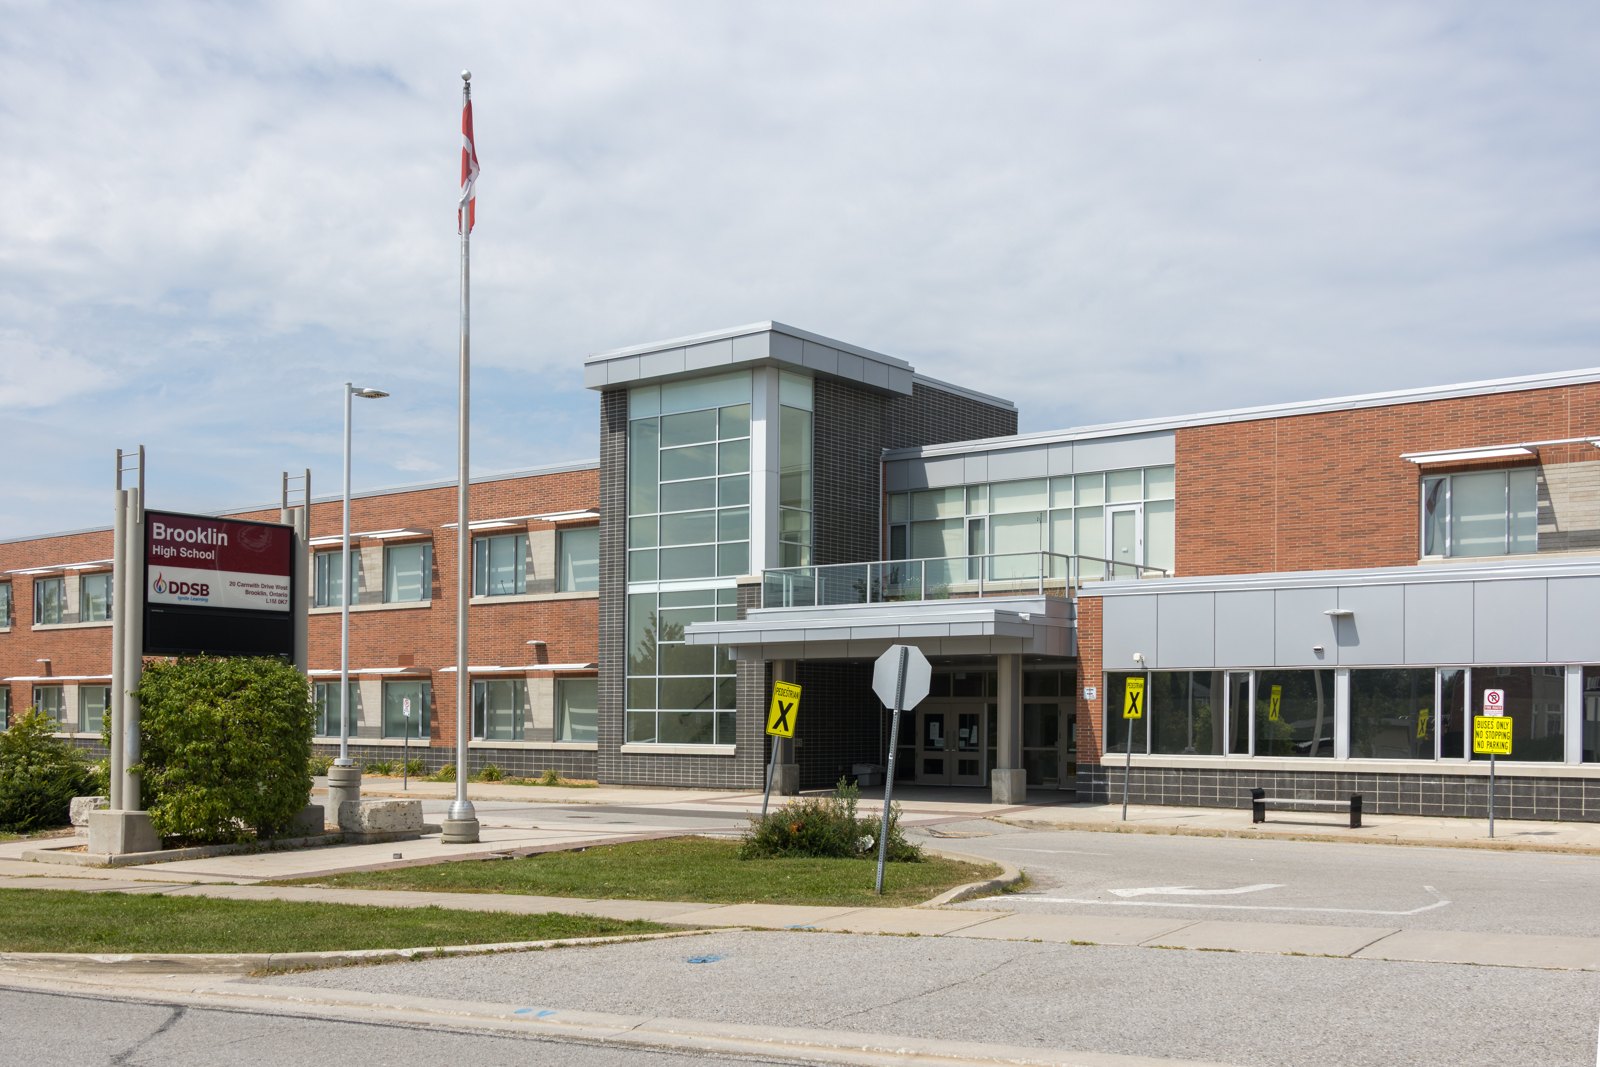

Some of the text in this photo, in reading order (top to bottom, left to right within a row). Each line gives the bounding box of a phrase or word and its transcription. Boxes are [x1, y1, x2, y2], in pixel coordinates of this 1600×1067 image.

[152, 522, 228, 546] Brooklin
[152, 545, 215, 560] High School
[168, 581, 210, 597] DDSB
[776, 687, 799, 699] PEDESTRIAN
[1127, 691, 1140, 714] X
[772, 699, 794, 732] X
[1476, 720, 1510, 730] BUSES ONLY
[1475, 730, 1511, 740] NO STOPPING
[1476, 740, 1509, 750] NO PARKING
